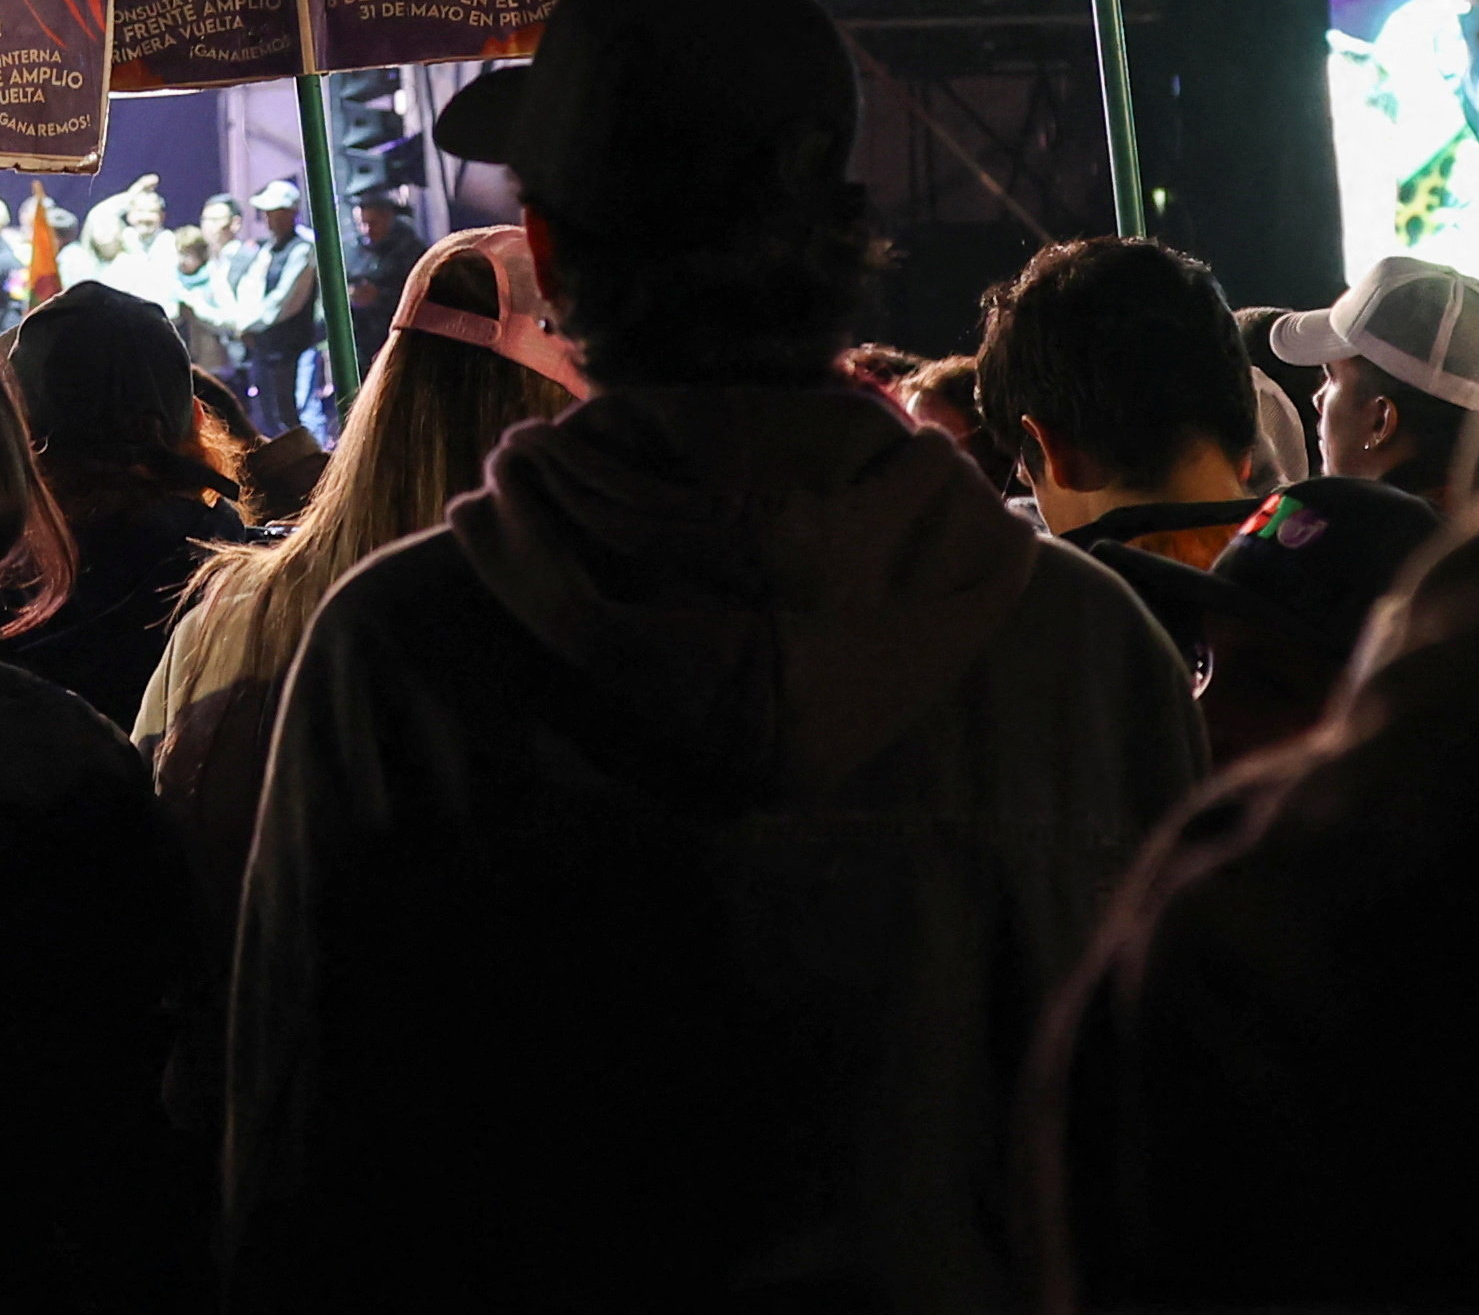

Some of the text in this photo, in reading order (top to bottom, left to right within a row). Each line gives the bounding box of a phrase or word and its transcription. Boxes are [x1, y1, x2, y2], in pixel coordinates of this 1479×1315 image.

[123, 4, 197, 44] FRENTE
[180, 14, 244, 40] VUELTA
[359, 2, 493, 27] 31 DE MAYO EN
[9, 71, 83, 89] AMPLIO
